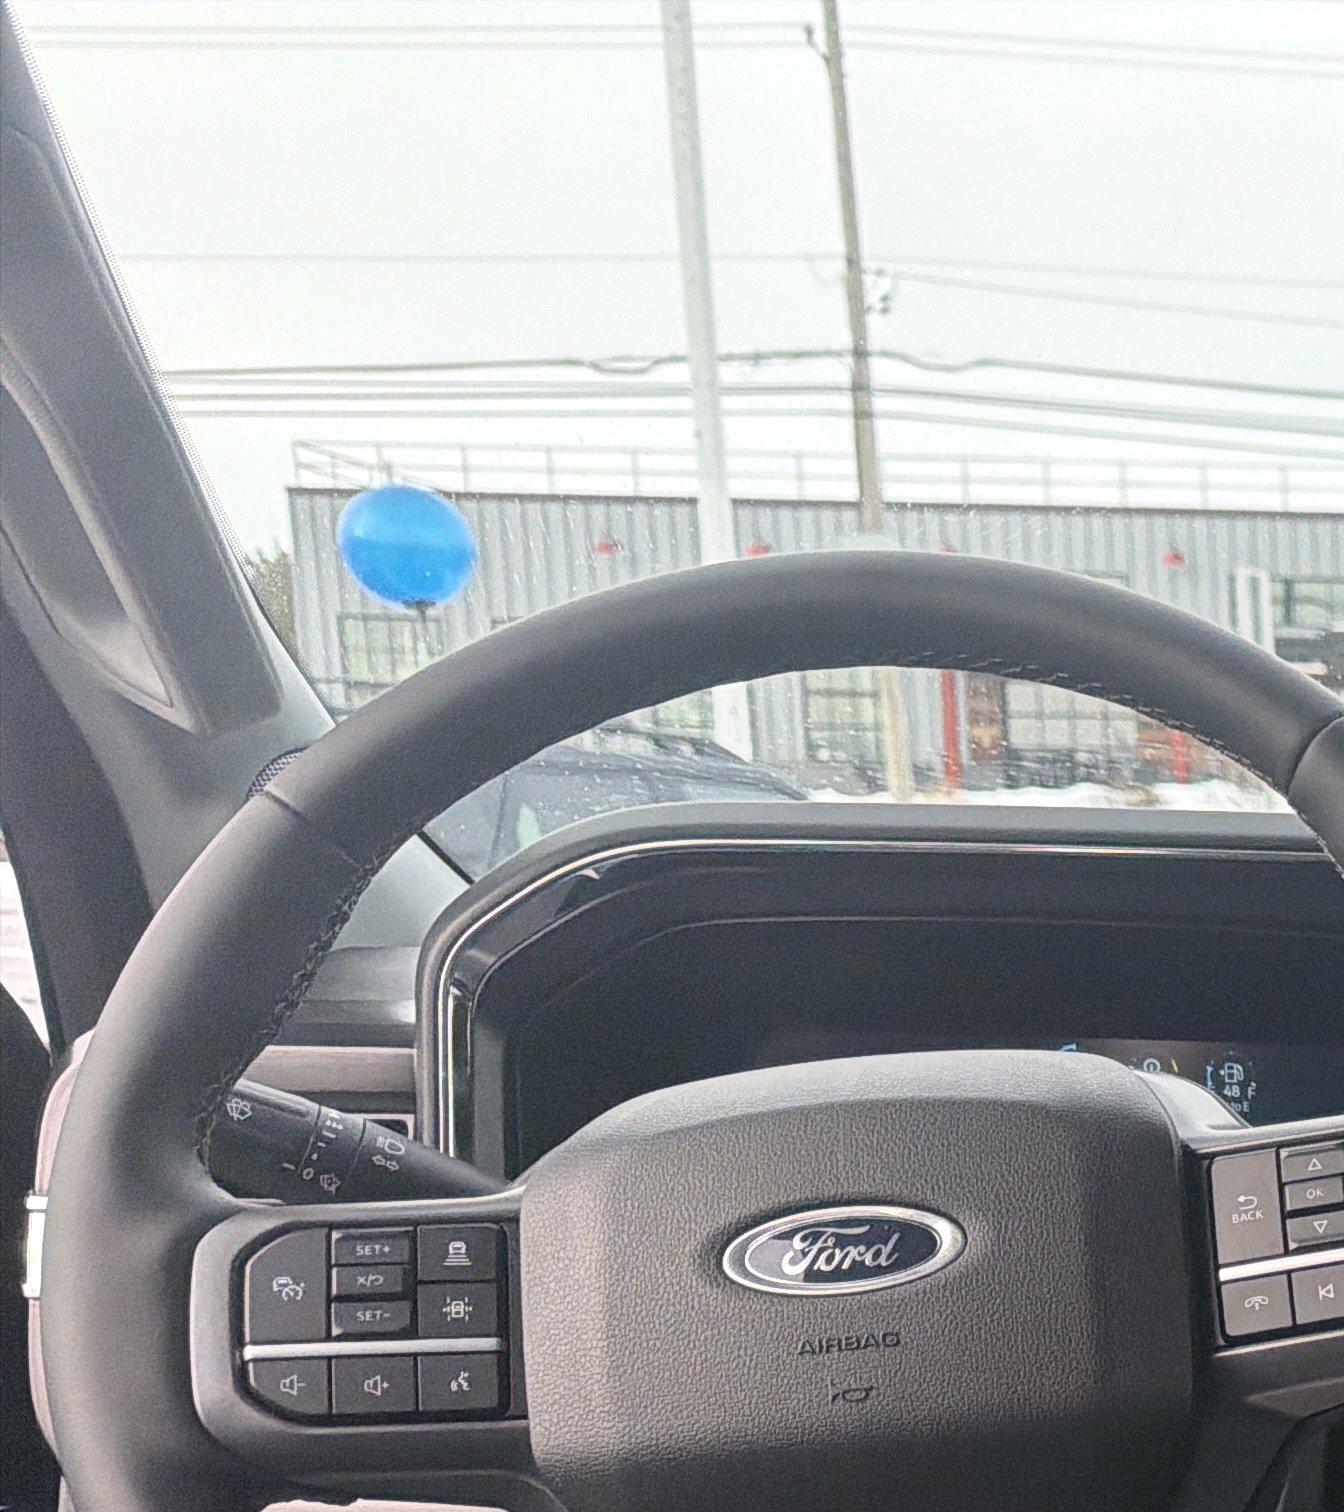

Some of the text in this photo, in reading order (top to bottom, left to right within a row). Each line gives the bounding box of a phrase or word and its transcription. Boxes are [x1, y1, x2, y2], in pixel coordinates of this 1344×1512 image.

[1306, 1188, 1325, 1200] OK
[1232, 1210, 1264, 1224] BACK
[356, 1244, 391, 1256] SET+
[781, 1225, 899, 1276] Ford
[799, 1331, 900, 1356] AIRBAG
